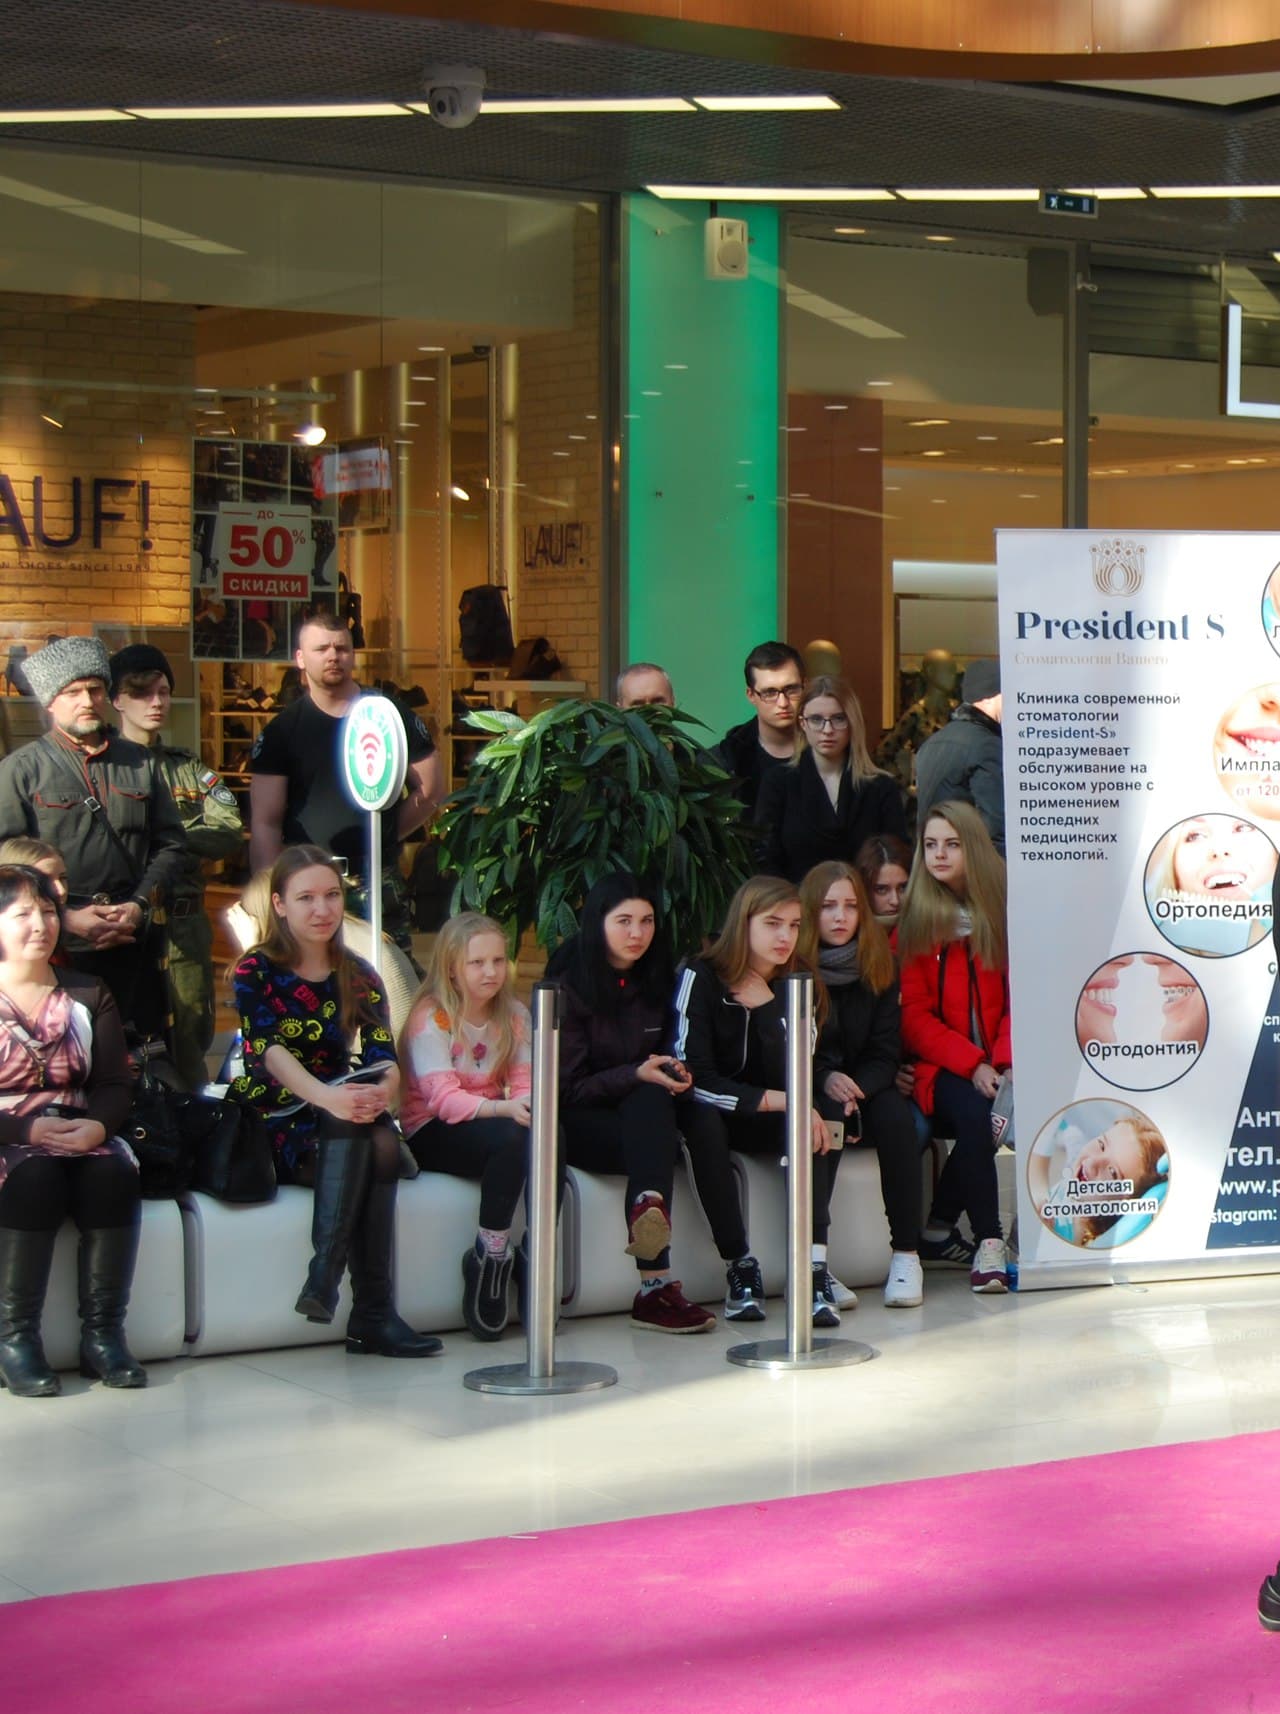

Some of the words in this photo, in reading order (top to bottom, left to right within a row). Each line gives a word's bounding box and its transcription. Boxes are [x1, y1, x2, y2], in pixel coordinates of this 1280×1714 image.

[1015, 610, 1190, 640] President
[1206, 613, 1225, 640] S
[1017, 692, 1079, 704] Клиника
[1084, 693, 1180, 707] современной
[1017, 711, 1119, 721] стоматологии
[1018, 726, 1116, 739] «President-S»
[1019, 747, 1130, 759] подразумевает
[1018, 762, 1126, 776] обслуживание
[1130, 764, 1148, 774] на
[1019, 781, 1086, 792] высоком
[1090, 781, 1142, 794] уровне
[1146, 781, 1154, 791] с
[1019, 798, 1120, 811] применением
[1020, 816, 1100, 827] последних
[1021, 833, 1117, 845] медицинских
[1021, 848, 1108, 861] технологий.
[1156, 900, 1273, 922] Ортопедия
[1087, 1042, 1197, 1060] Ортодонтия
[1066, 1180, 1132, 1196] Детская
[1043, 1200, 1157, 1217] стоматология
